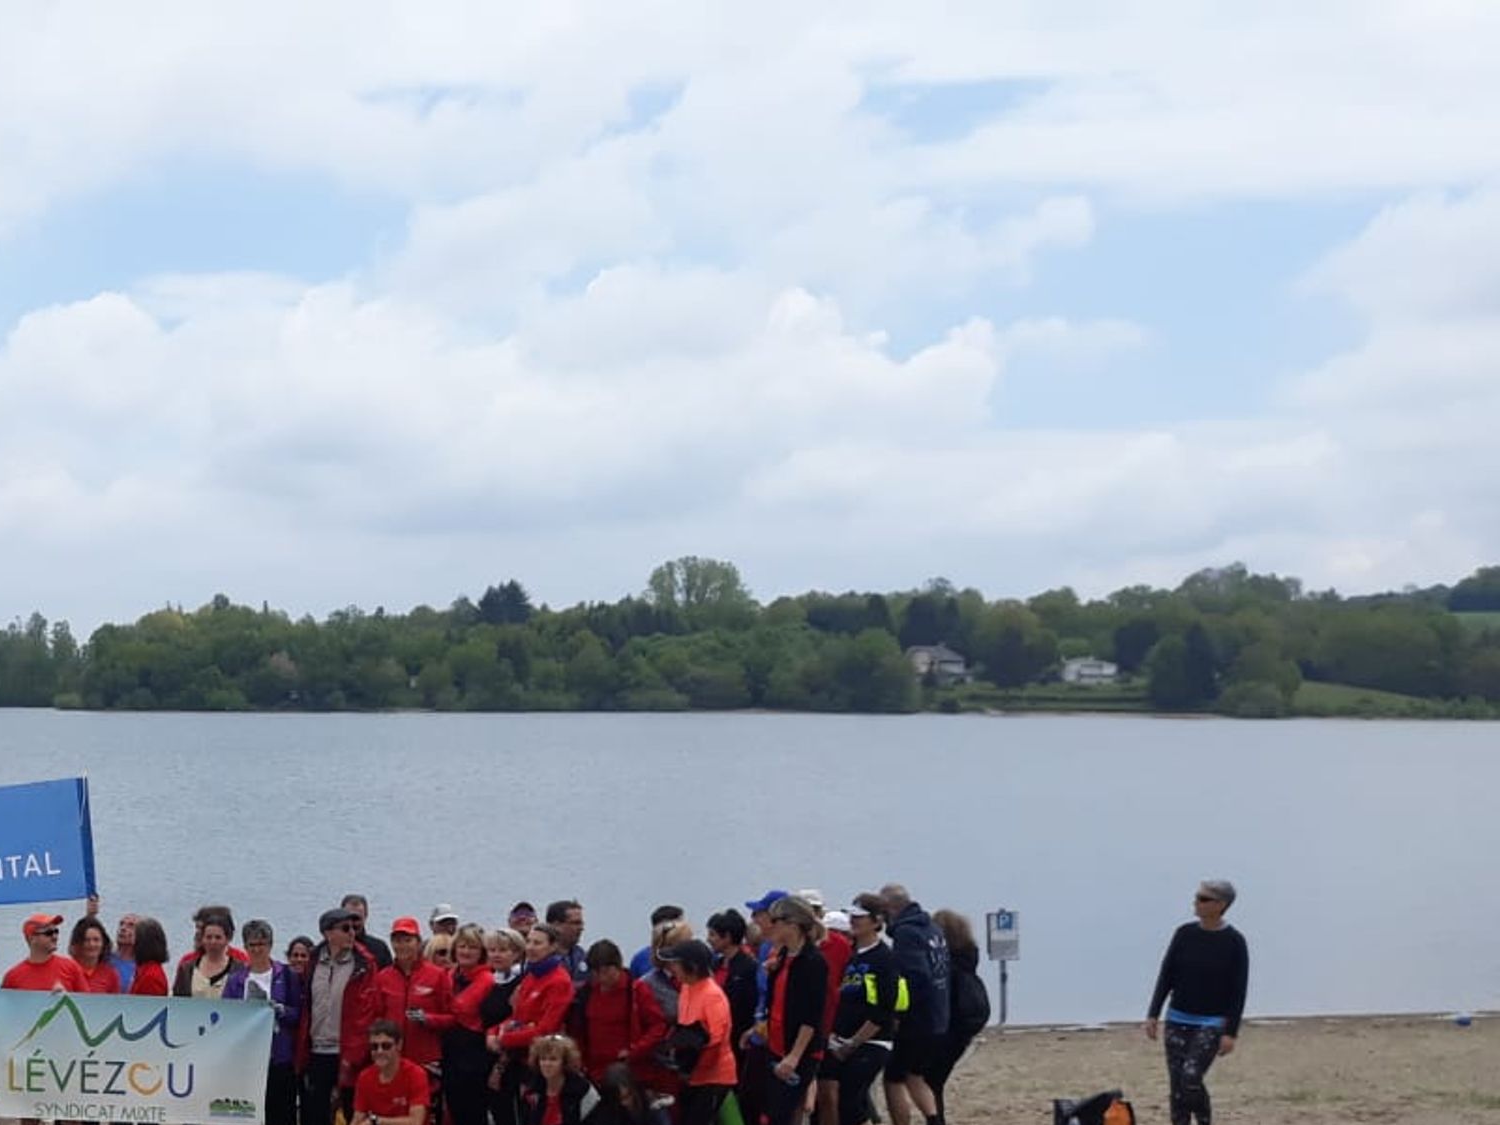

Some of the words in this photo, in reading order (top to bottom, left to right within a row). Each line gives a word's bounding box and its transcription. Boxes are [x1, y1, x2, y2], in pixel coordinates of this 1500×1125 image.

[7, 1049, 194, 1099] LÉVÉZOU
[34, 1102, 116, 1121] SYNDICAT
[119, 1105, 167, 1122] MIXTE
